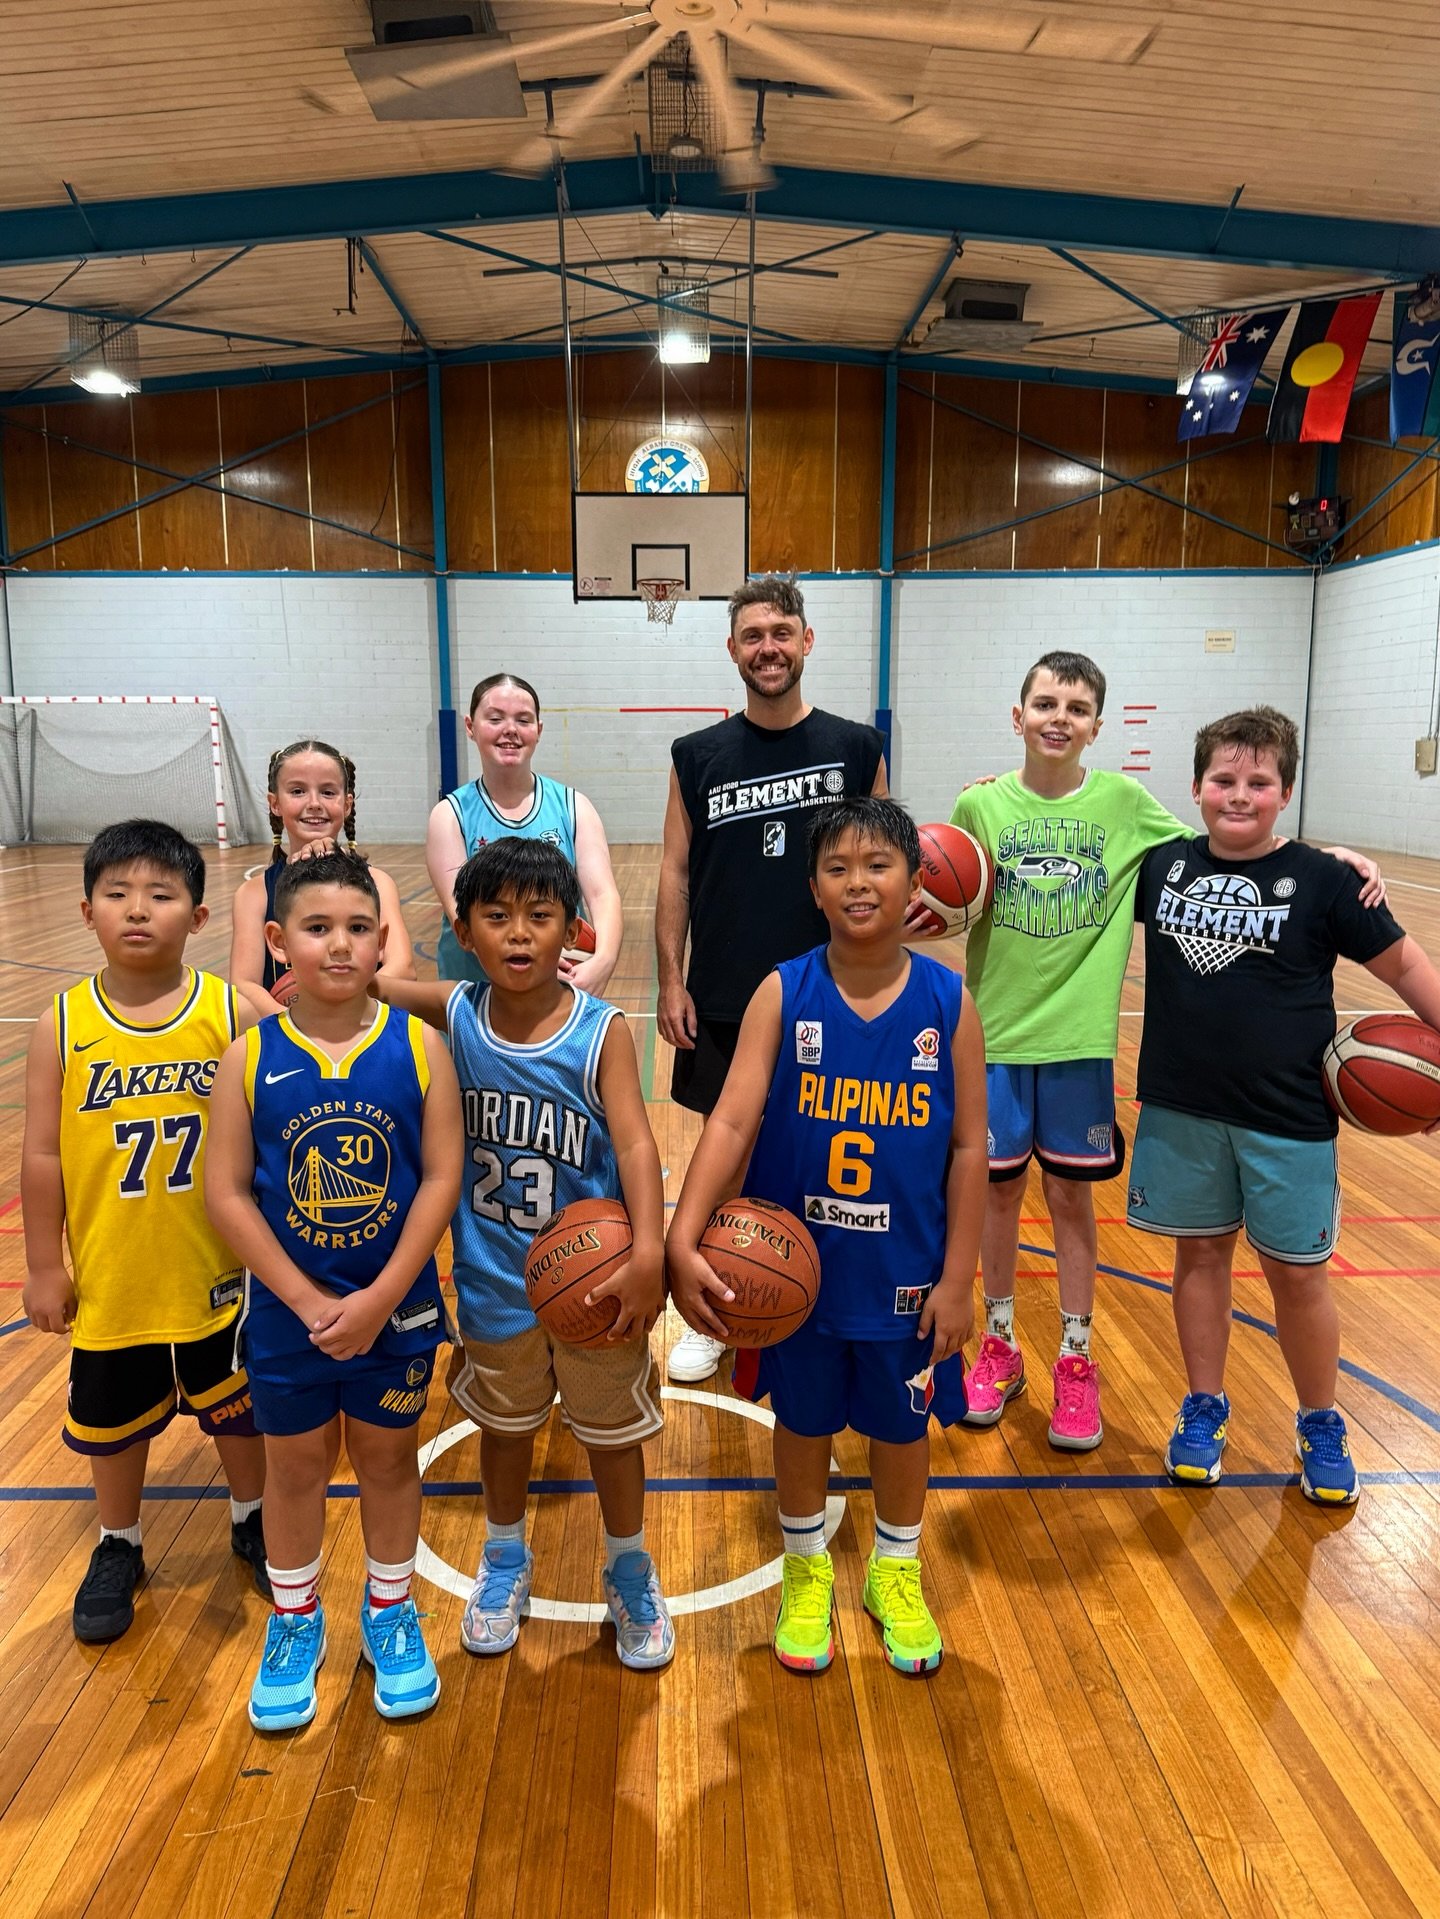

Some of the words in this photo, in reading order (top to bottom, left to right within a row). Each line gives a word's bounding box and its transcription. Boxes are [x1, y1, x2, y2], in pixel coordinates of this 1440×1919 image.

[642, 441, 668, 454] ALBANY
[670, 441, 693, 454] CREEK
[708, 773, 822, 821] ELEMENT
[800, 794, 845, 808] BASKETBALL
[998, 817, 1105, 865] SEATTLE
[992, 863, 1109, 939] SEAHAWKS
[1155, 889, 1290, 943] ELEMENT
[1161, 921, 1268, 948] BASKETBALL
[802, 1047, 820, 1058] SBP
[77, 1058, 220, 1114] LAKERS
[282, 1100, 346, 1140] GOLDEN
[354, 1101, 396, 1134] STATE
[460, 1087, 590, 1173] ORDAN
[112, 1111, 204, 1199] 77
[336, 1134, 374, 1167] 30
[827, 1130, 876, 1198] 6
[472, 1144, 557, 1232] 23
[285, 1199, 399, 1249] WARRIORS
[828, 1204, 888, 1229] Smart
